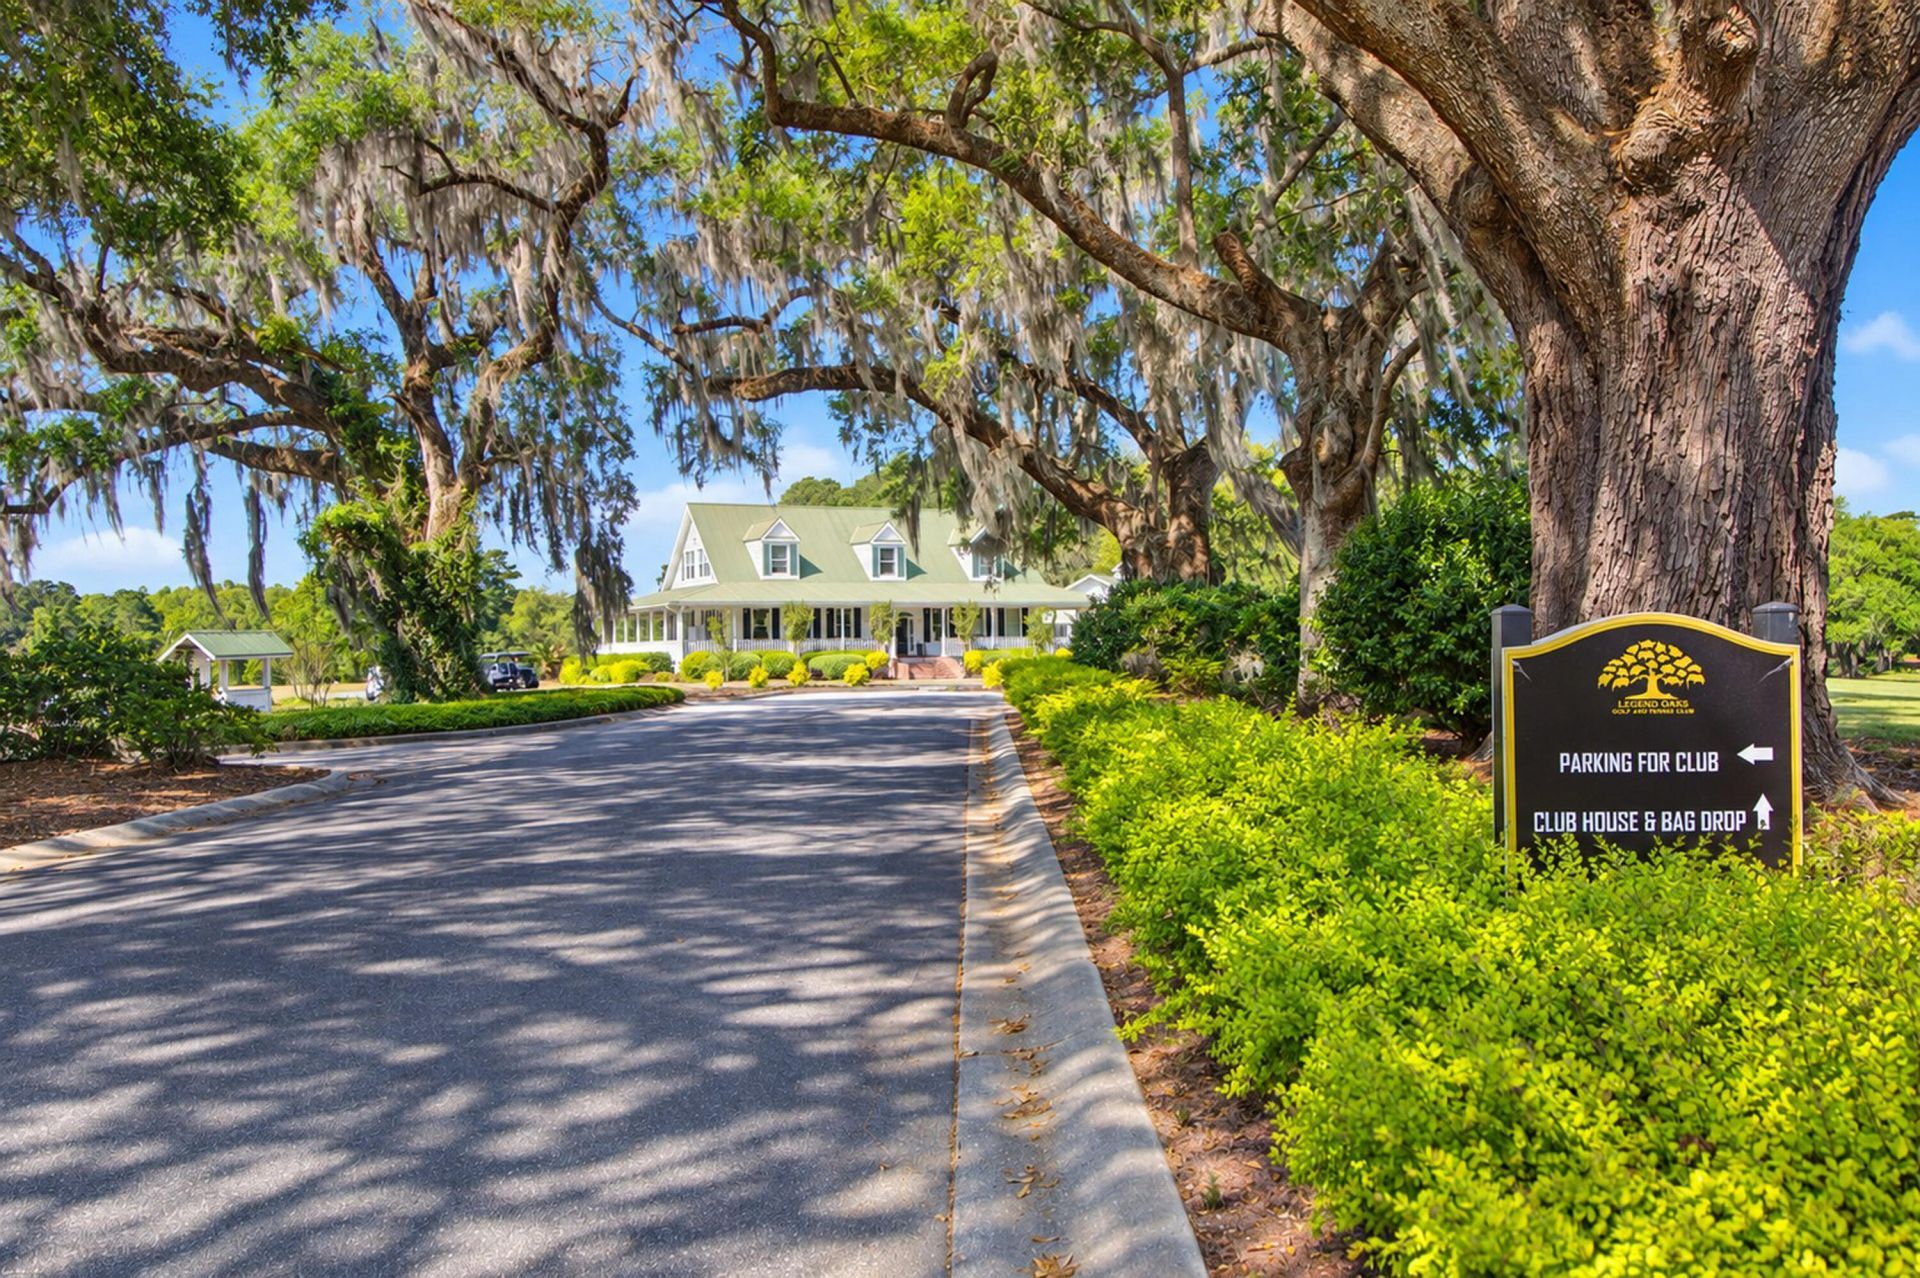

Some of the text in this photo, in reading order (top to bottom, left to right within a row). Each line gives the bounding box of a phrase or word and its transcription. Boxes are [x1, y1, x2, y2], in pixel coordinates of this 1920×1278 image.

[1618, 700, 1689, 708] LEGEND OAKS
[1559, 751, 1720, 774] PARKING FOR CLUB
[1533, 810, 1748, 833] CLUB HOUSE & BAG DROP
